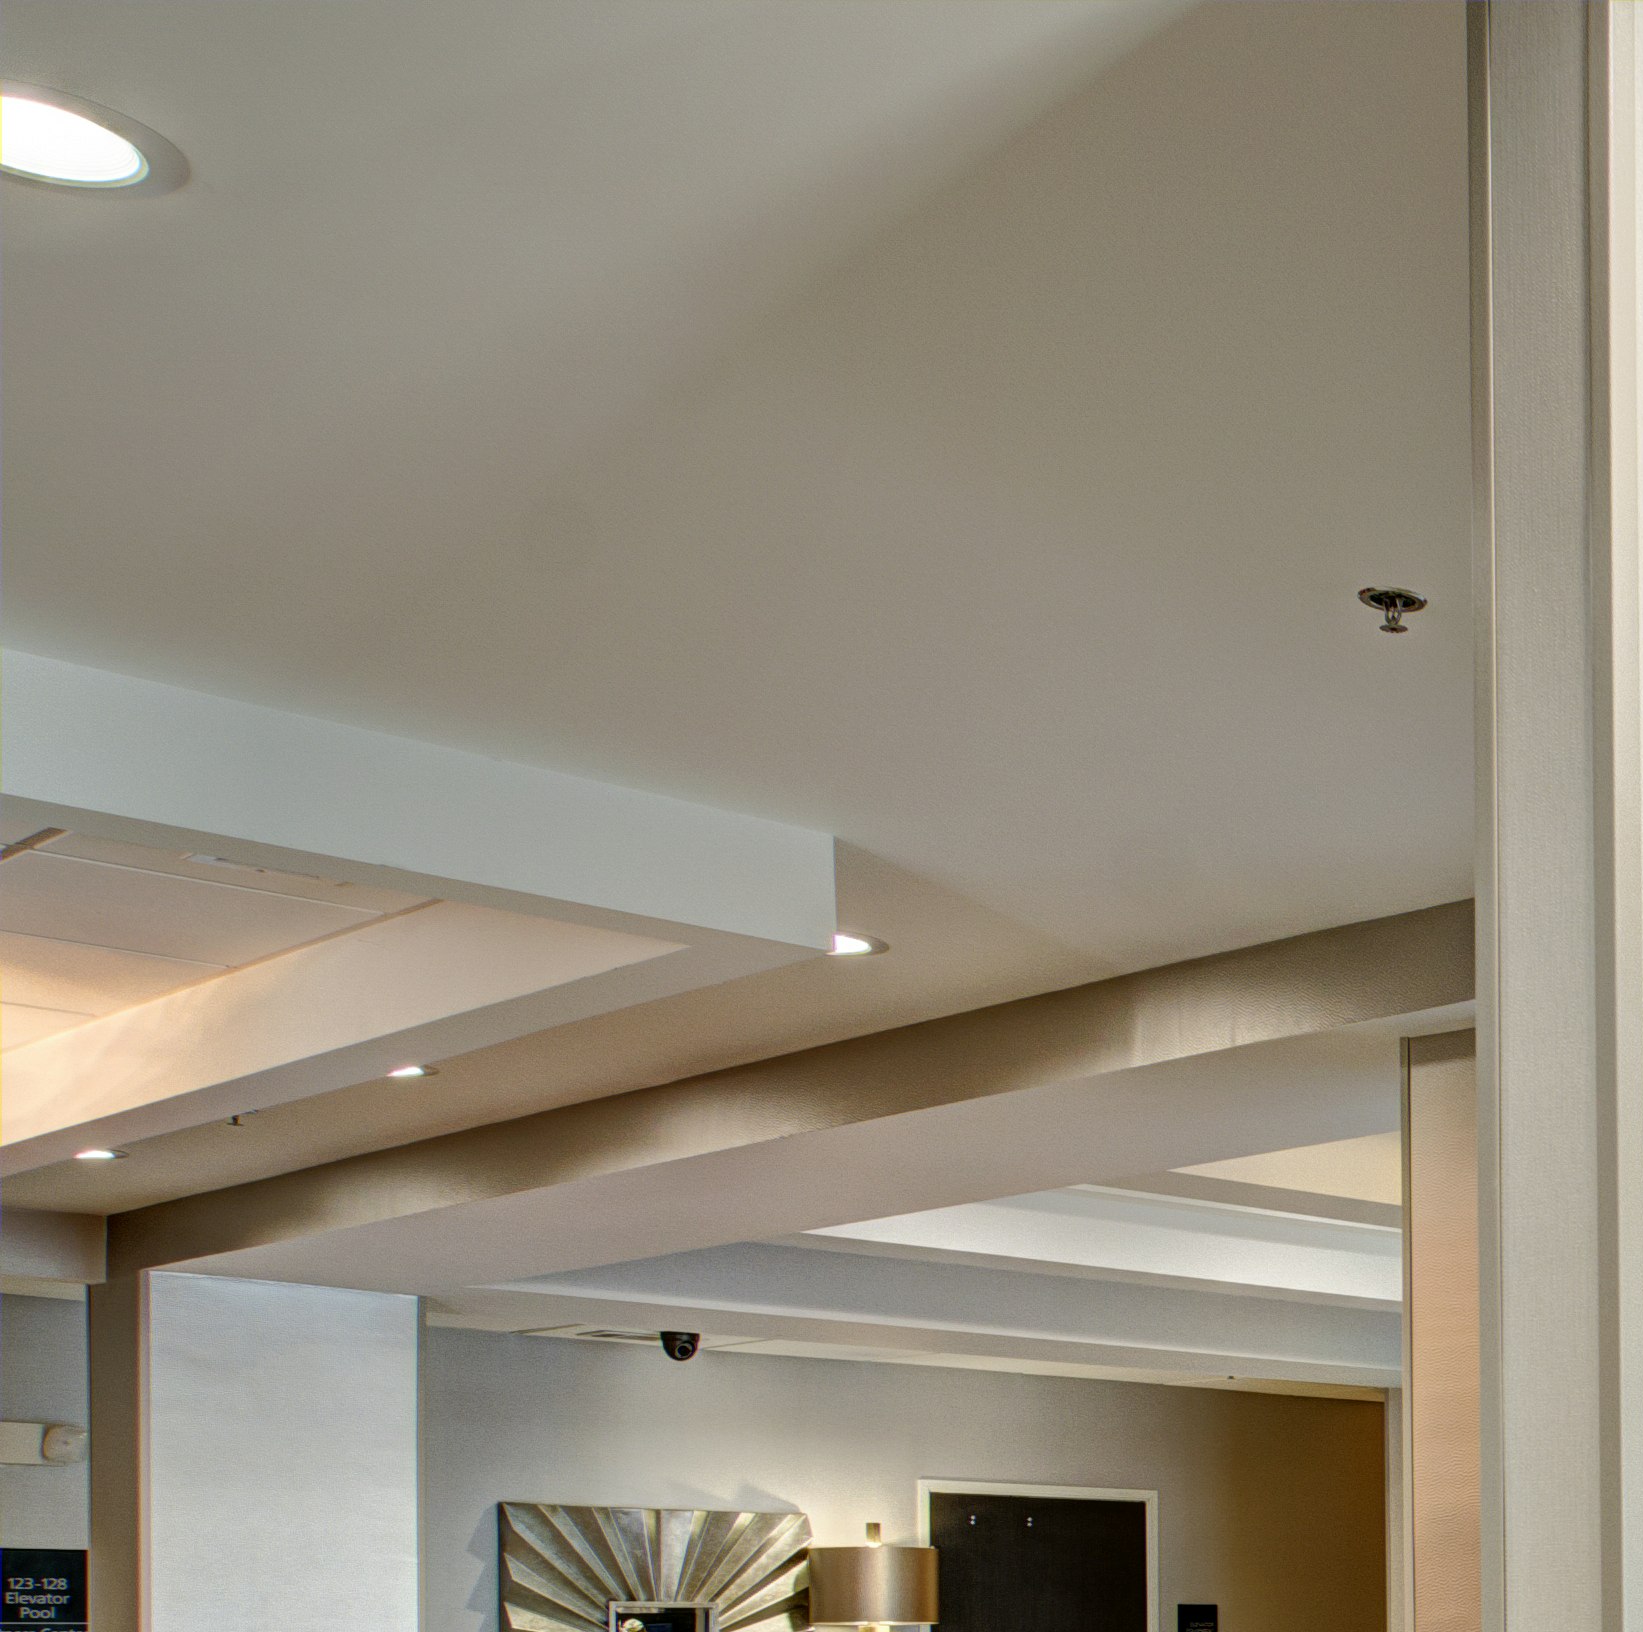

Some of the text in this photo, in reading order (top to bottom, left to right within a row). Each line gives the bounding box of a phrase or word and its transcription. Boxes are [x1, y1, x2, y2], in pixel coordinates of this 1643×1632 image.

[7, 1577, 69, 1590] 123-128
[5, 1591, 71, 1605] Elevator
[19, 1606, 57, 1620] Pool
